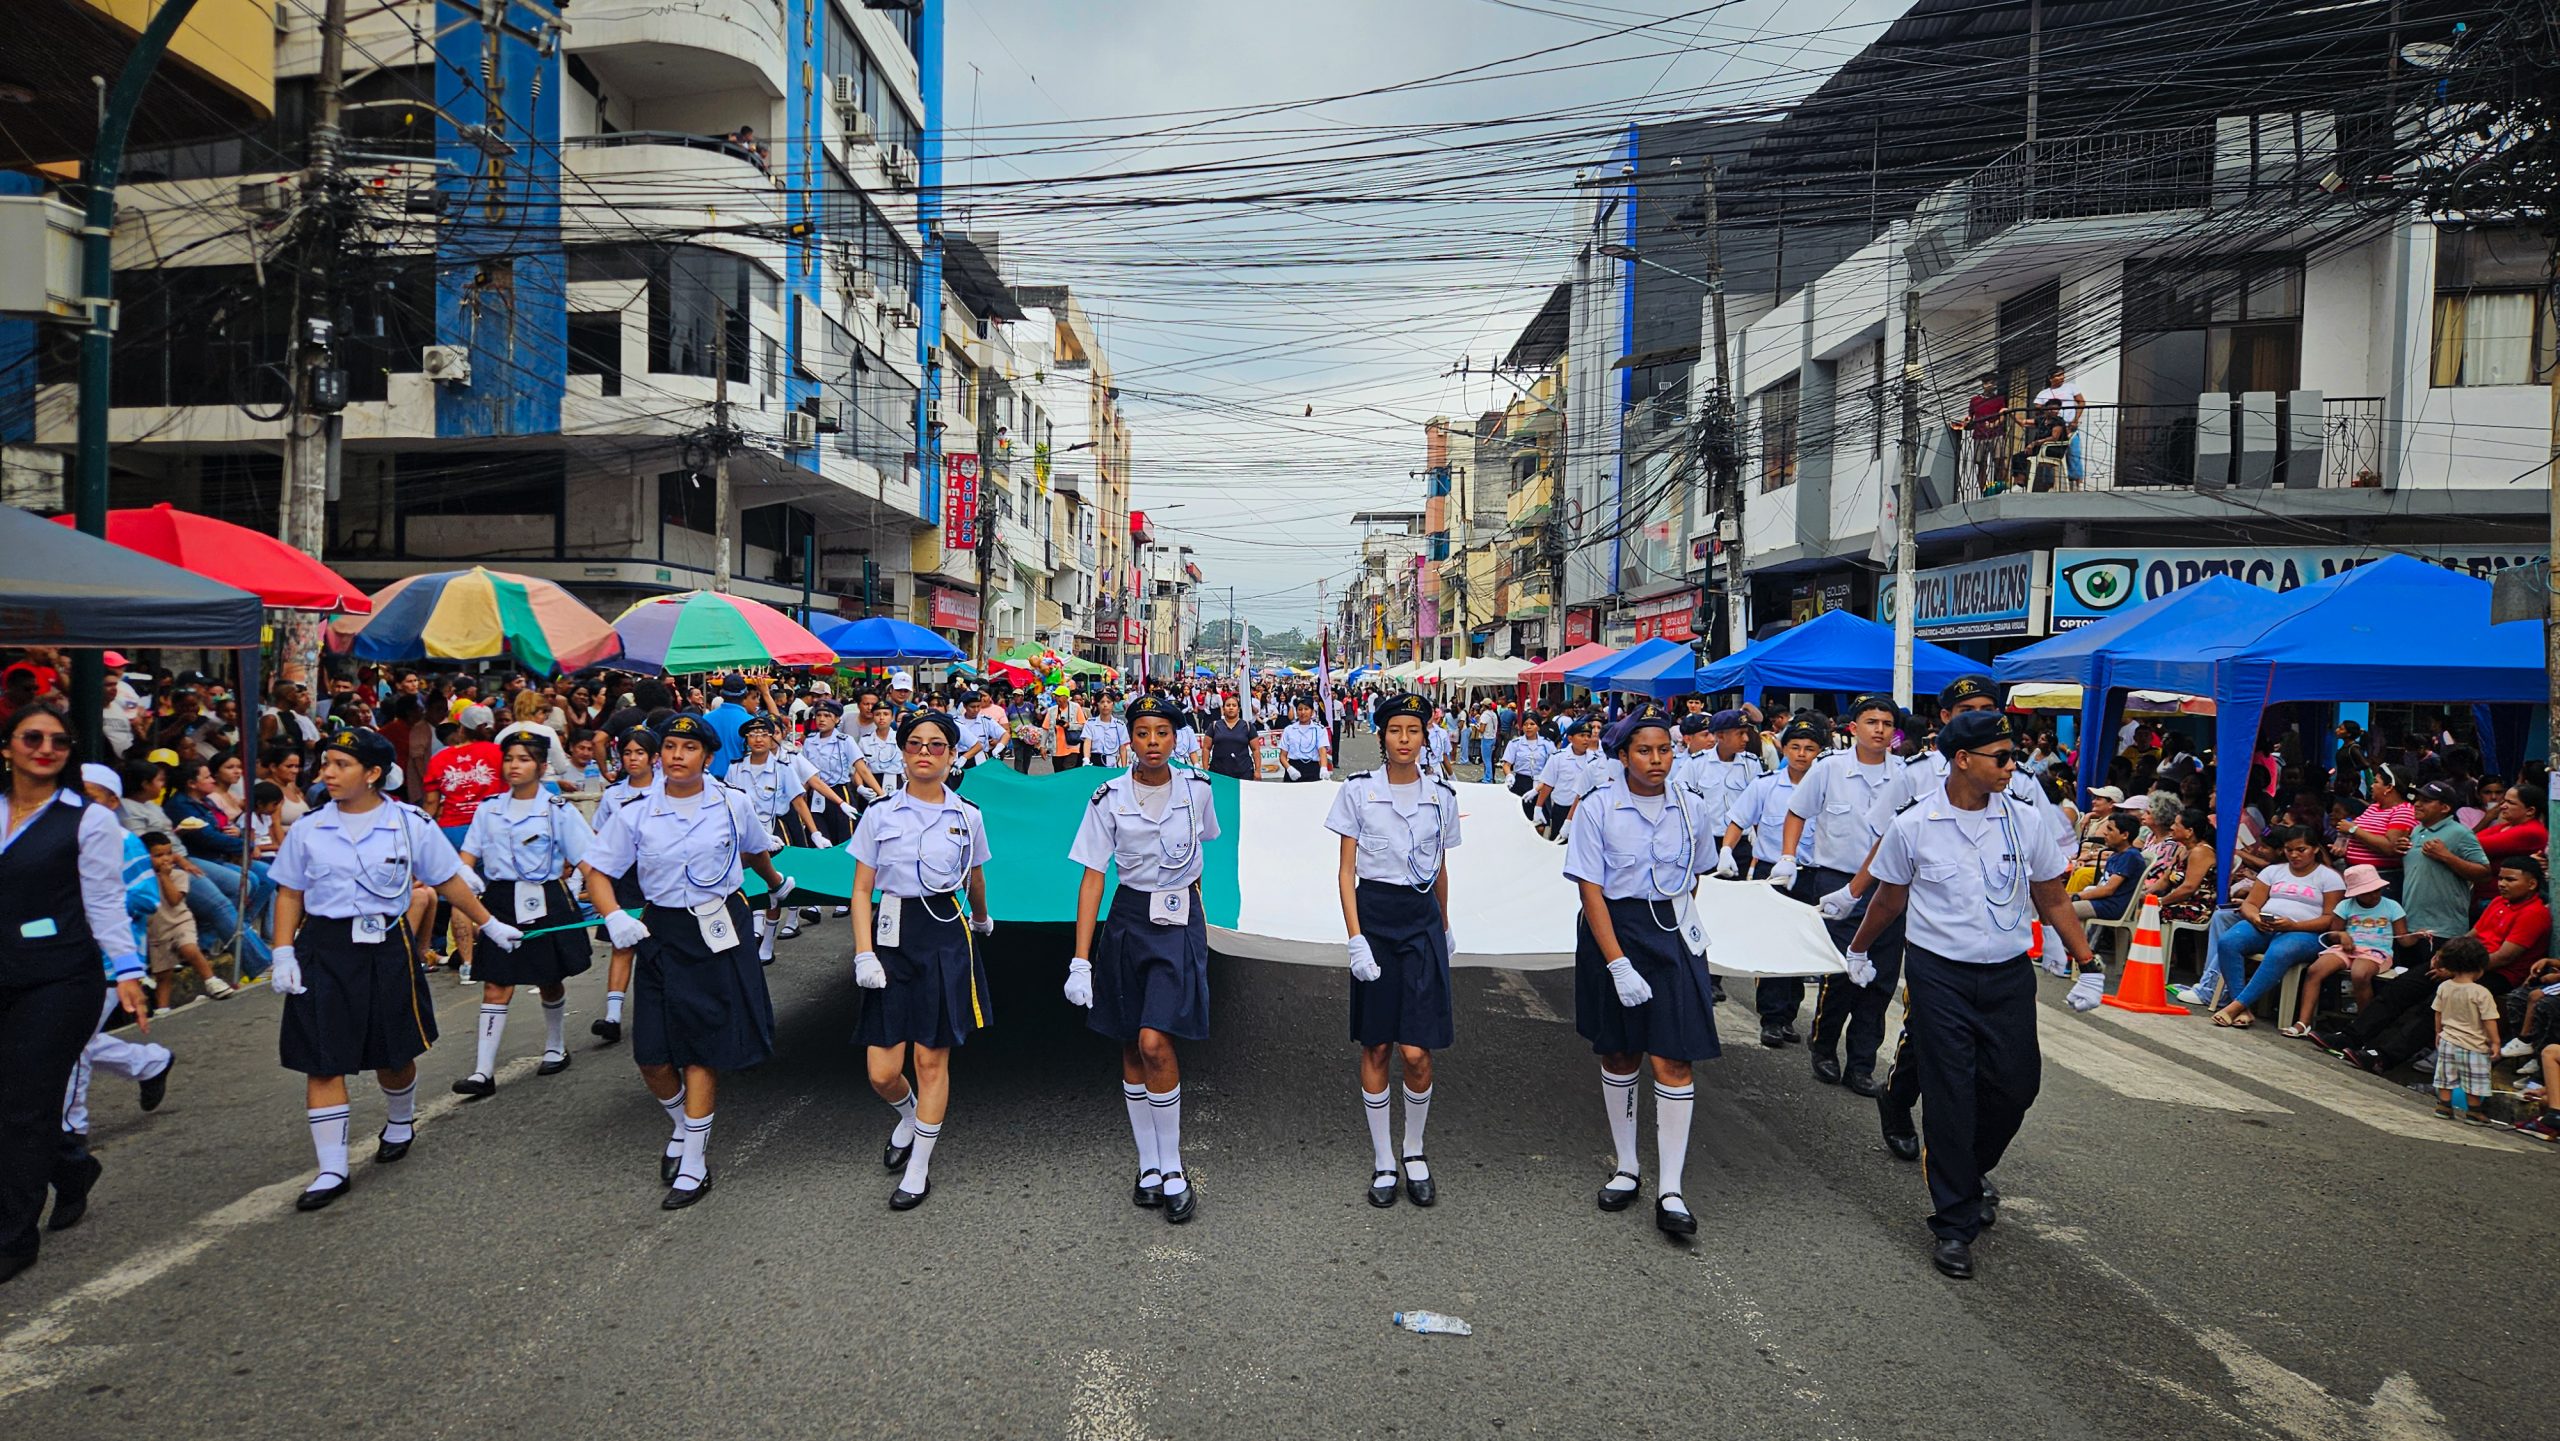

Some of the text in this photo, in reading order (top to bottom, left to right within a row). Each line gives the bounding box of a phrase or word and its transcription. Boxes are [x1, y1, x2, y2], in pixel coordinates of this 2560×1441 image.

[486, 32, 506, 222] ILARO
[802, 59, 813, 276] MILAGO
[948, 455, 960, 548] farmacias
[962, 480, 974, 543] suiza
[1826, 584, 1850, 597] GOLDEN
[1826, 598, 1843, 610] BEAR
[1914, 563, 2028, 619] PTICA MEGALENS
